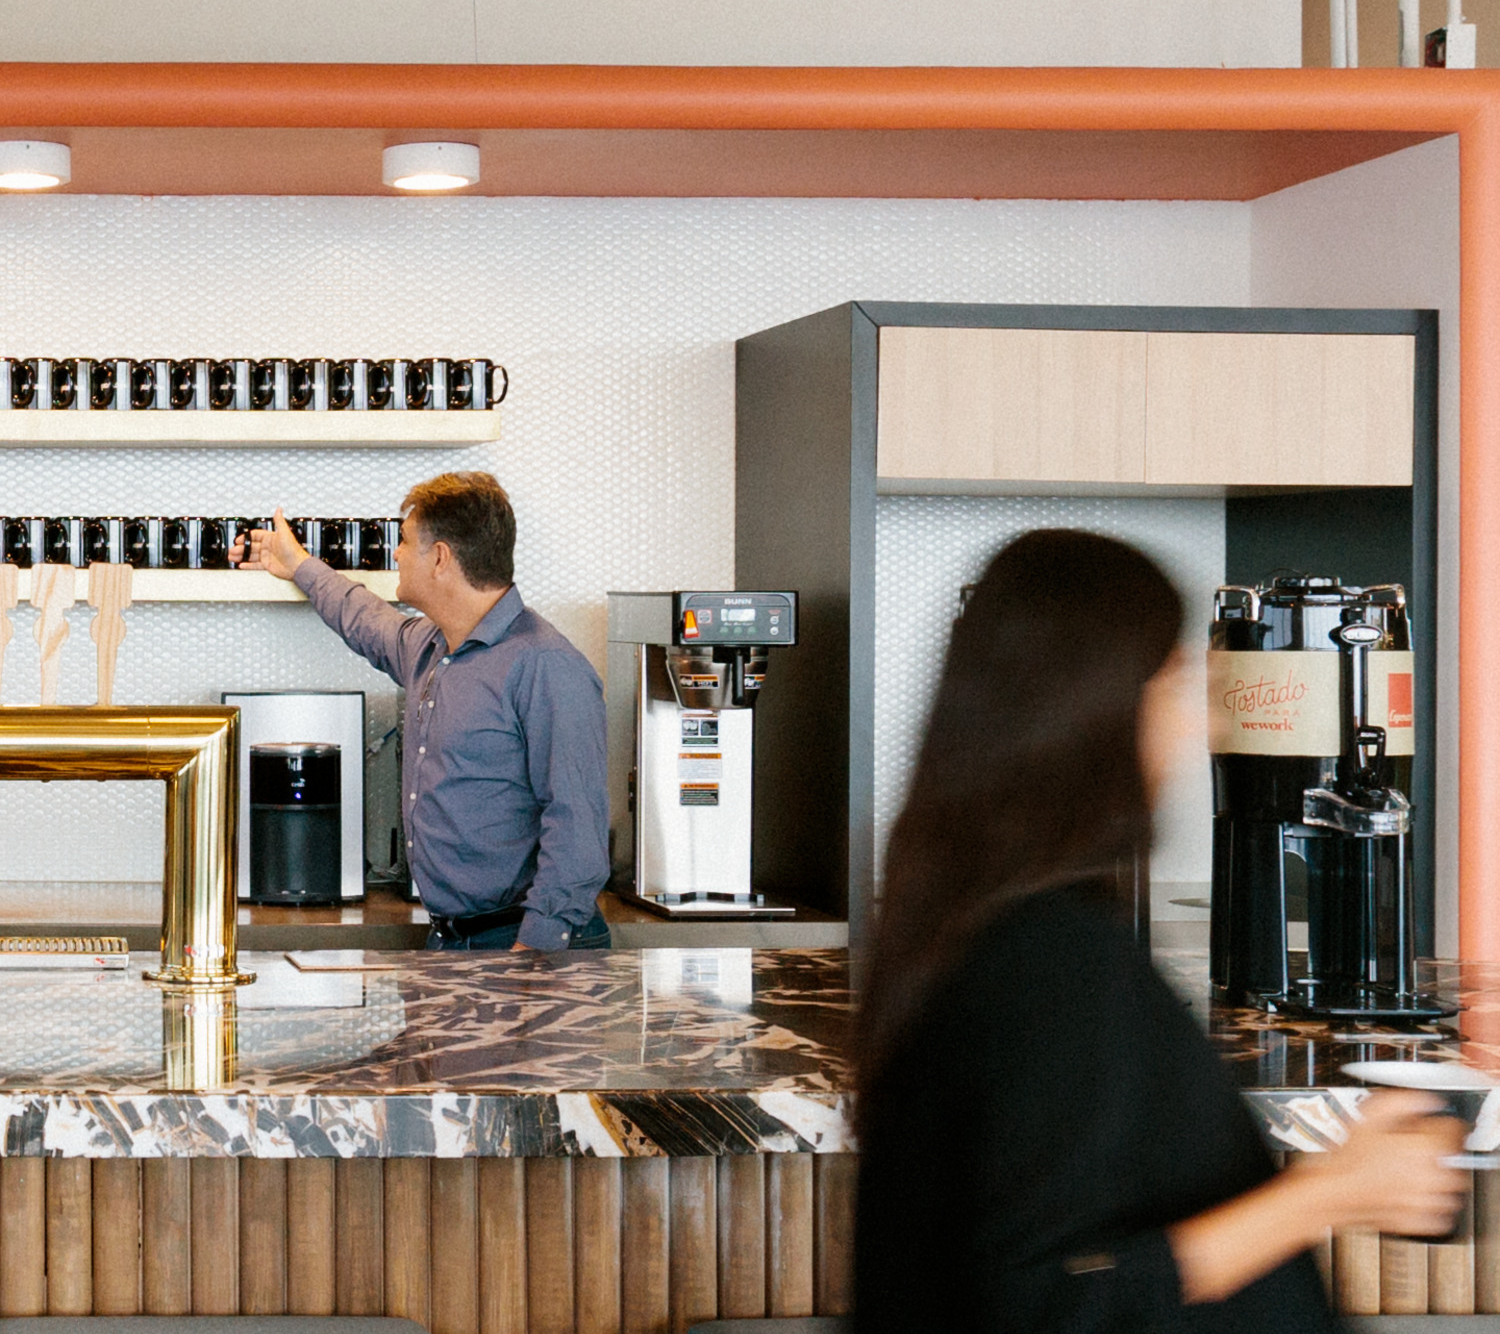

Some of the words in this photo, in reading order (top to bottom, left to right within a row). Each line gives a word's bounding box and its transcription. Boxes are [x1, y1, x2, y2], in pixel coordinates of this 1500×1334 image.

[1223, 669, 1310, 715] Tostado
[1264, 709, 1300, 717] PARA
[1241, 718, 1294, 731] wework
